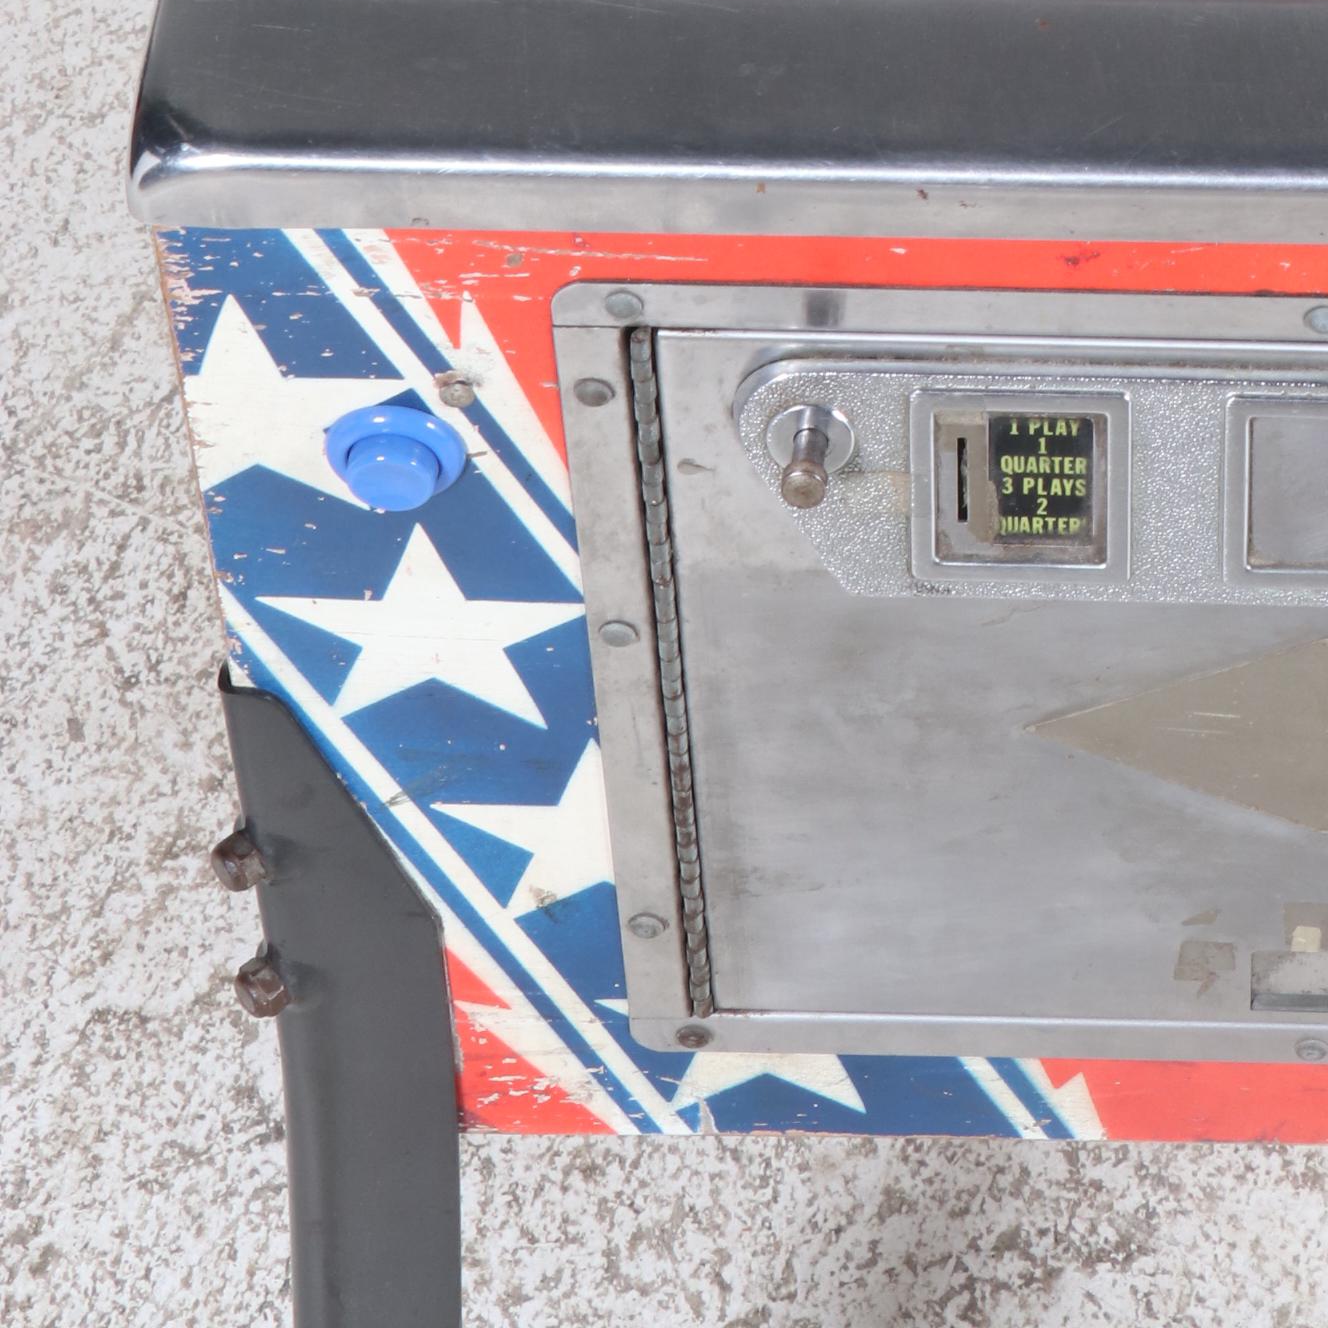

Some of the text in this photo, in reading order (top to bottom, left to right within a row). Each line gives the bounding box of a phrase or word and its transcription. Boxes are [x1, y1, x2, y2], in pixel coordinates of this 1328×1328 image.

[1029, 419, 1080, 436] PLAY
[1038, 437, 1047, 454] 1
[1000, 455, 1087, 474] QUARTER
[1002, 477, 1086, 496] 3 PLAYS
[1036, 498, 1048, 515] 2
